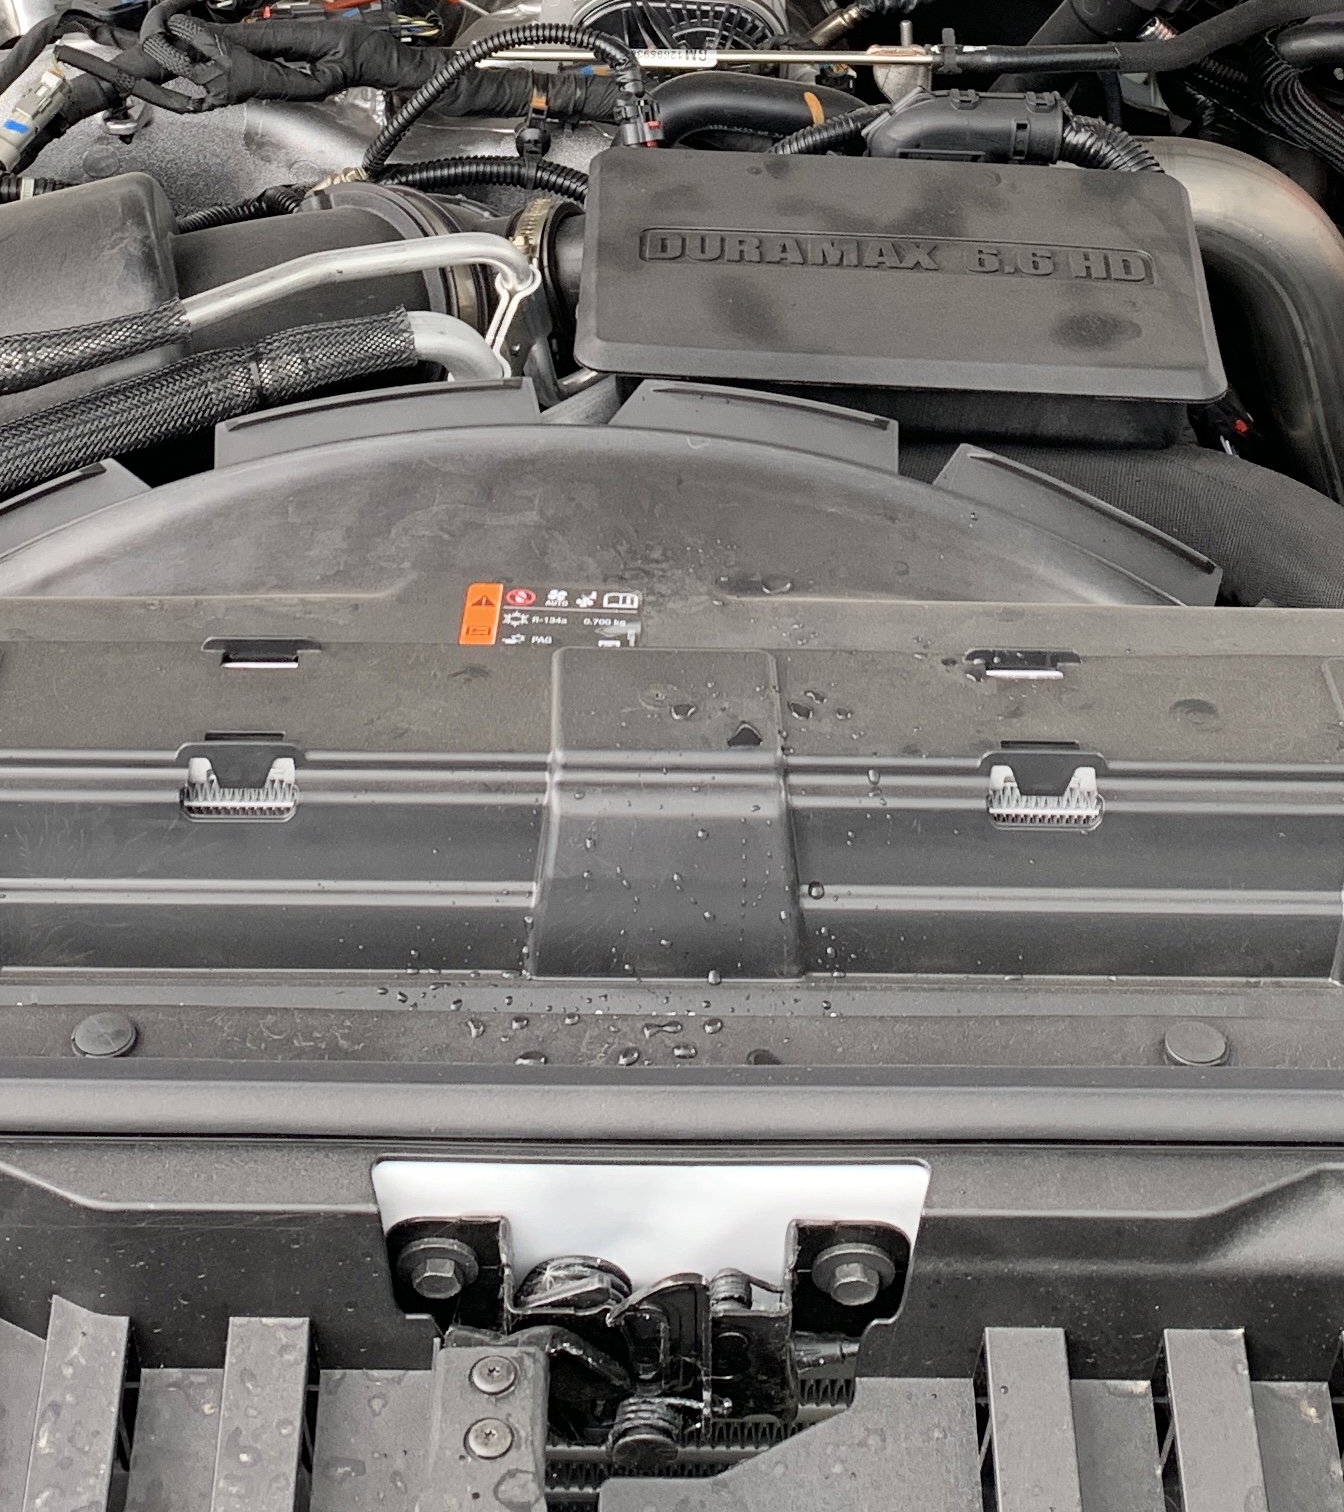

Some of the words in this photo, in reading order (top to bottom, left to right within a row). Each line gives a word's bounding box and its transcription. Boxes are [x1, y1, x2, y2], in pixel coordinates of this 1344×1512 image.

[650, 233, 939, 270] DURAMAX
[963, 246, 1056, 277] 6.6
[1070, 249, 1148, 283] HD
[544, 599, 569, 607] AUTO
[531, 615, 568, 625] R-134a
[583, 618, 612, 627] 0.700
